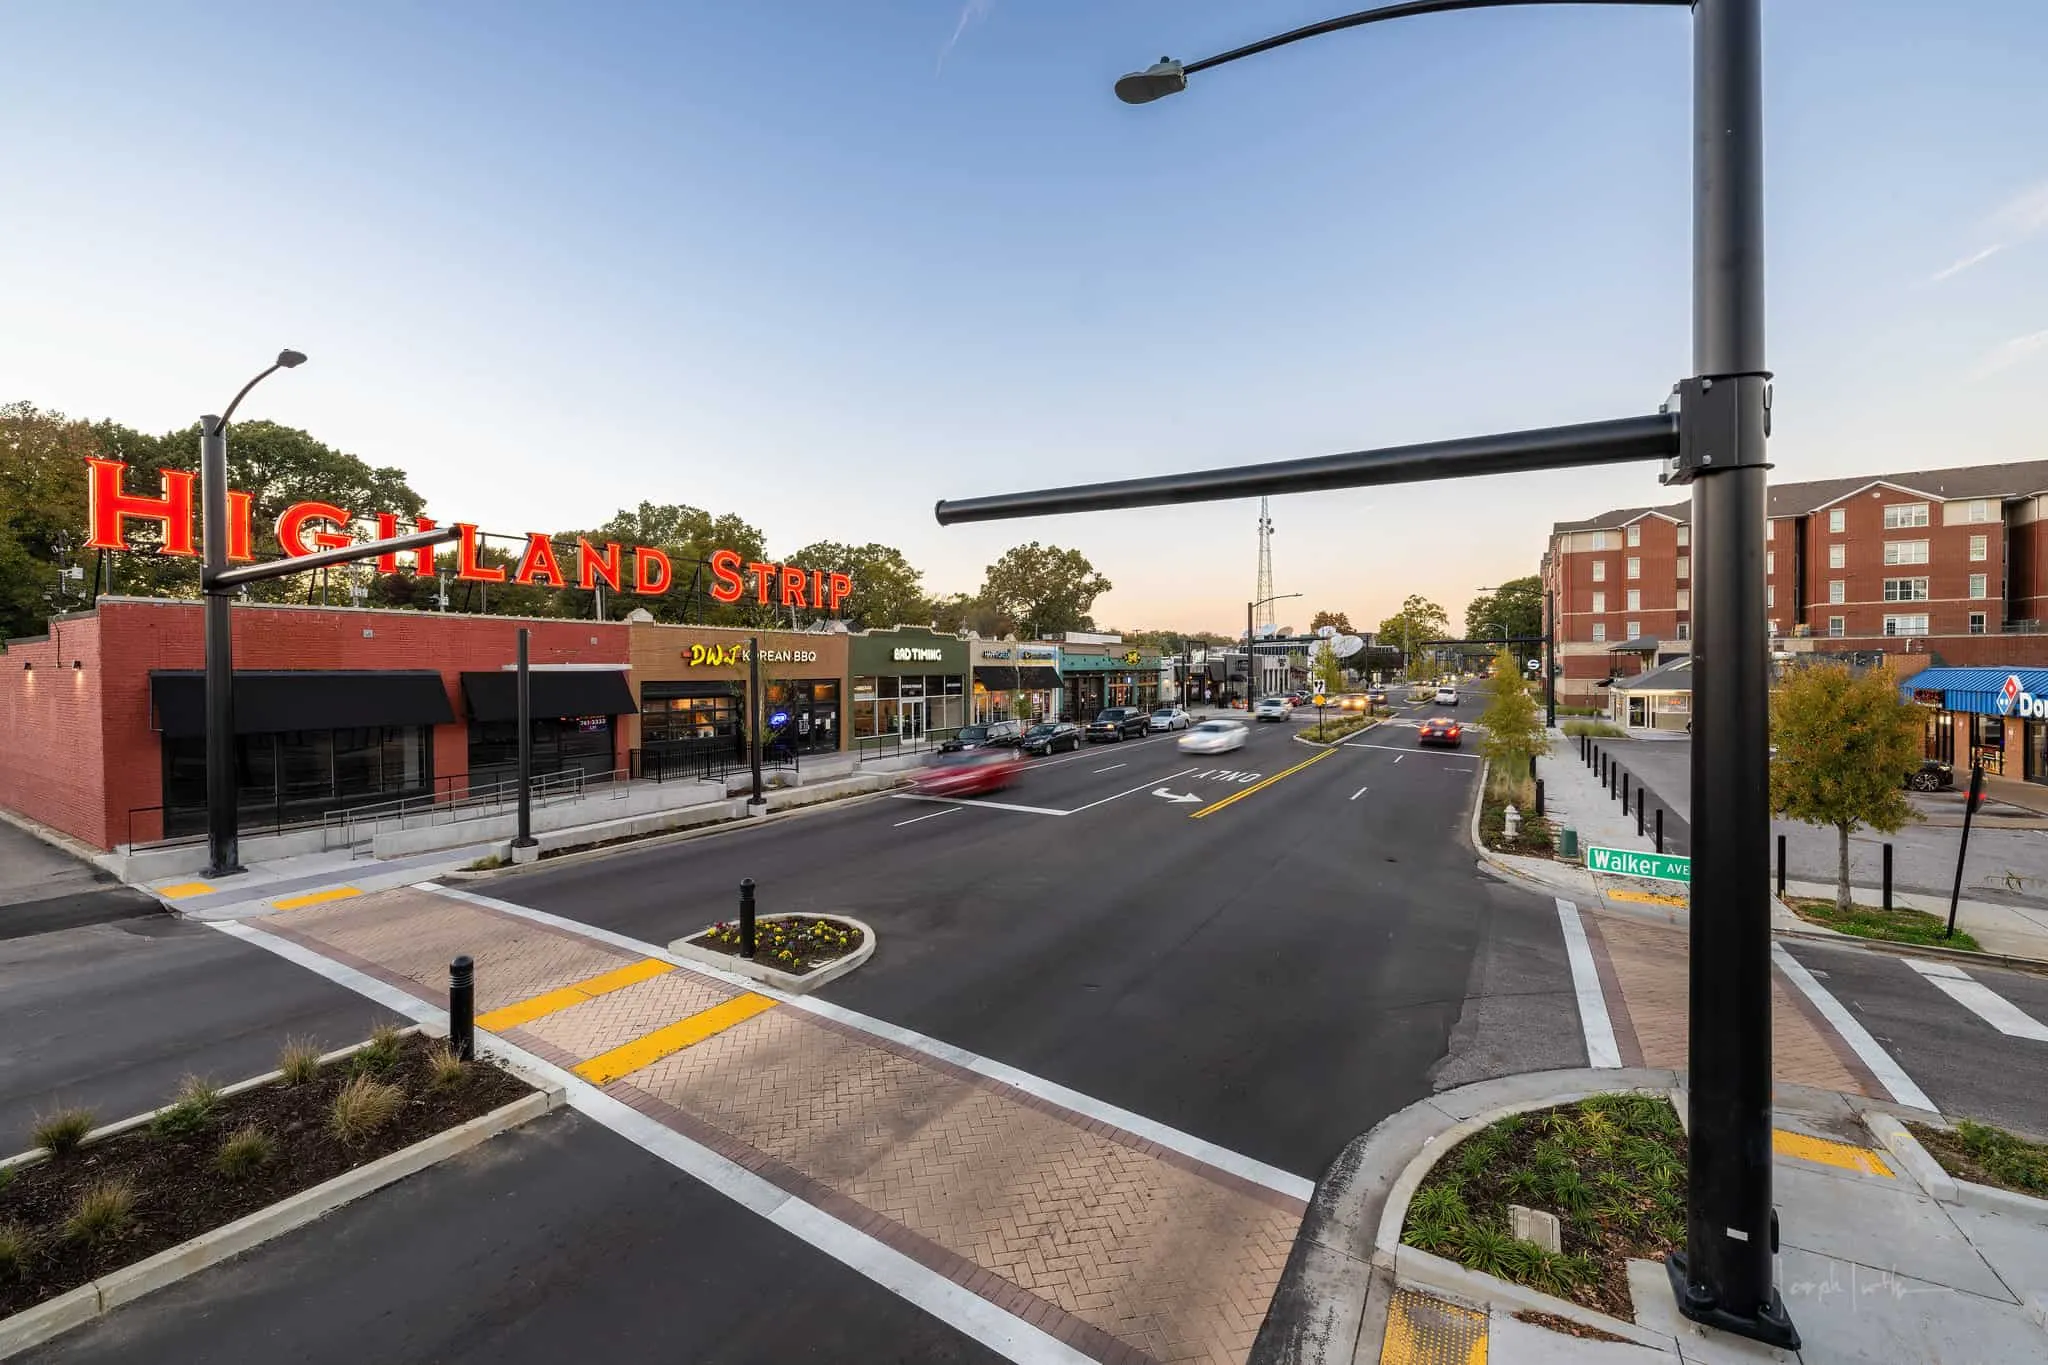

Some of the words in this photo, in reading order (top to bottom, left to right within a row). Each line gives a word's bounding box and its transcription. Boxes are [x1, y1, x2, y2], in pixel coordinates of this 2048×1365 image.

[84, 456, 672, 594] HIGHLAND
[709, 549, 853, 610] STRIP
[742, 650, 791, 662] KREAN
[793, 651, 817, 662] BBQ
[893, 648, 911, 661] BAD
[912, 648, 942, 661] TIMING
[1192, 768, 1262, 783] ONLY
[1594, 849, 1661, 876] Walker
[1667, 863, 1689, 876] AVE
